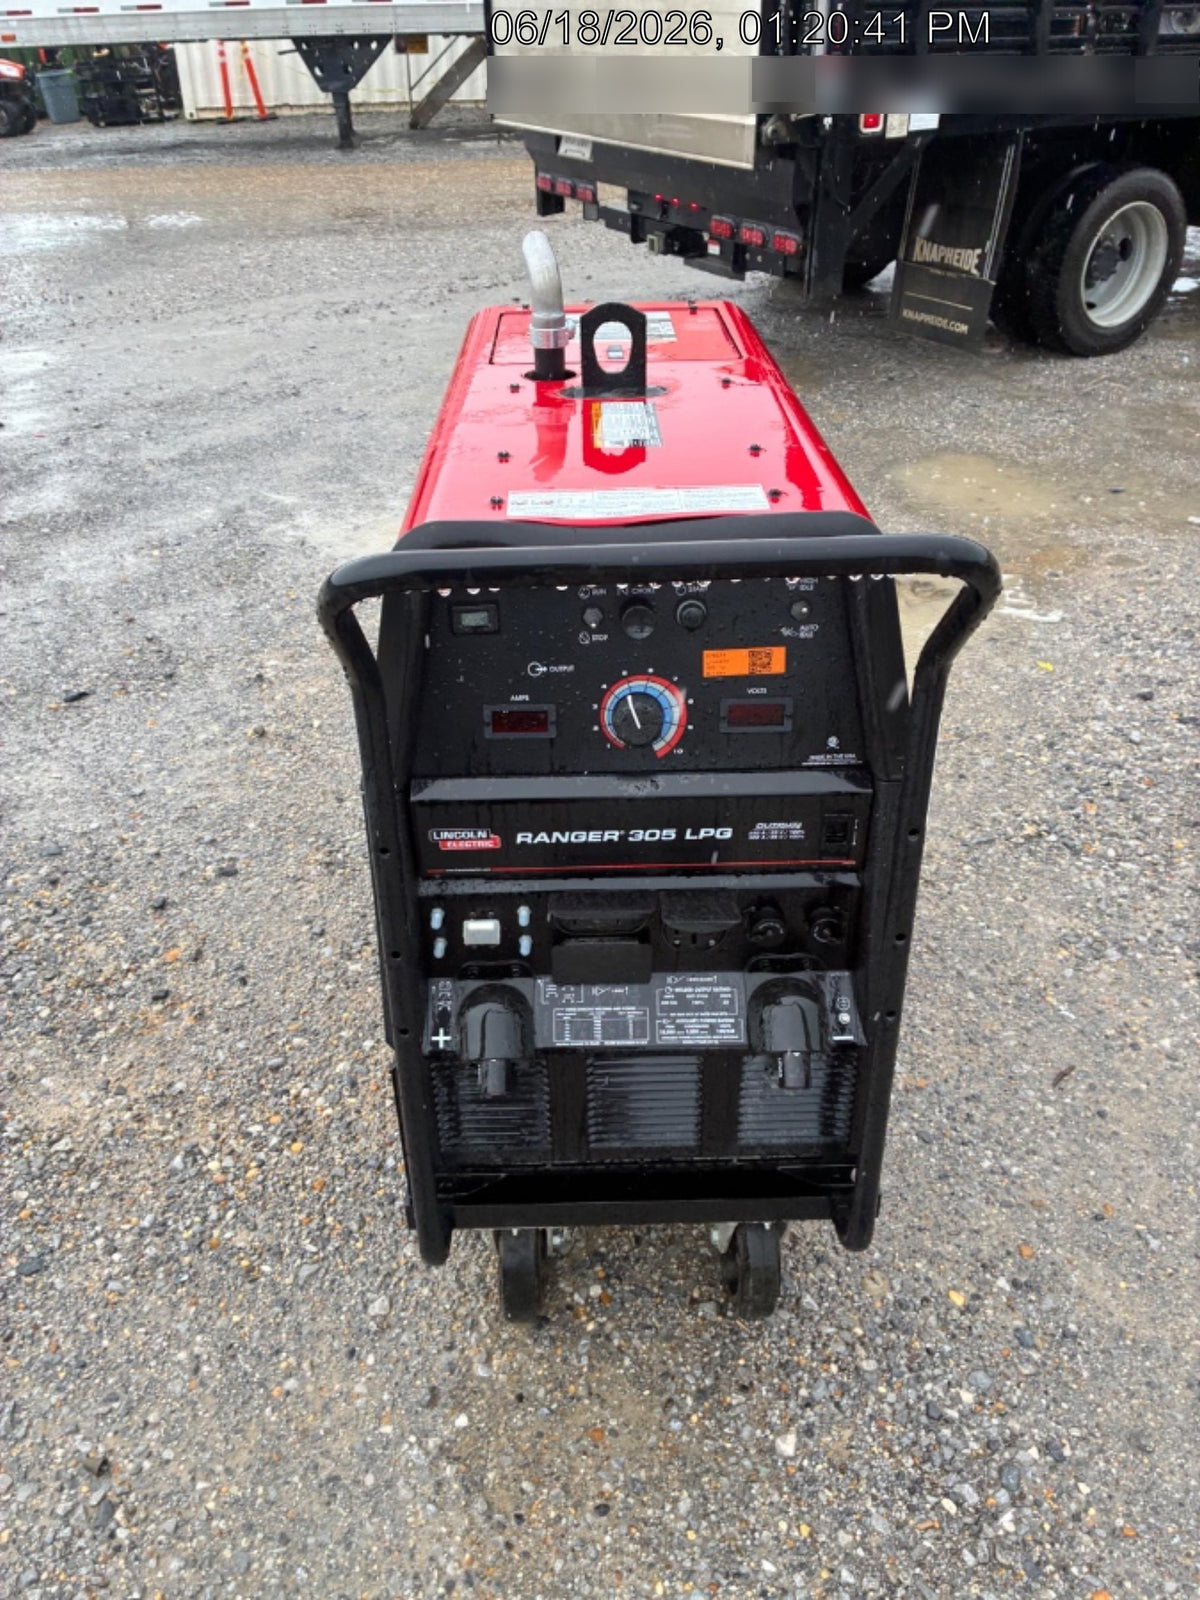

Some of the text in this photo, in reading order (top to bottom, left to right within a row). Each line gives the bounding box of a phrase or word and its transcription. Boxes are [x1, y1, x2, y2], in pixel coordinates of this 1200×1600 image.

[912, 236, 982, 277] KNAPHEIDE
[902, 308, 969, 335] KNAPHEIDE.COM
[433, 830, 488, 839] LINCOLN
[628, 828, 677, 841] 305
[685, 827, 733, 840] LPG
